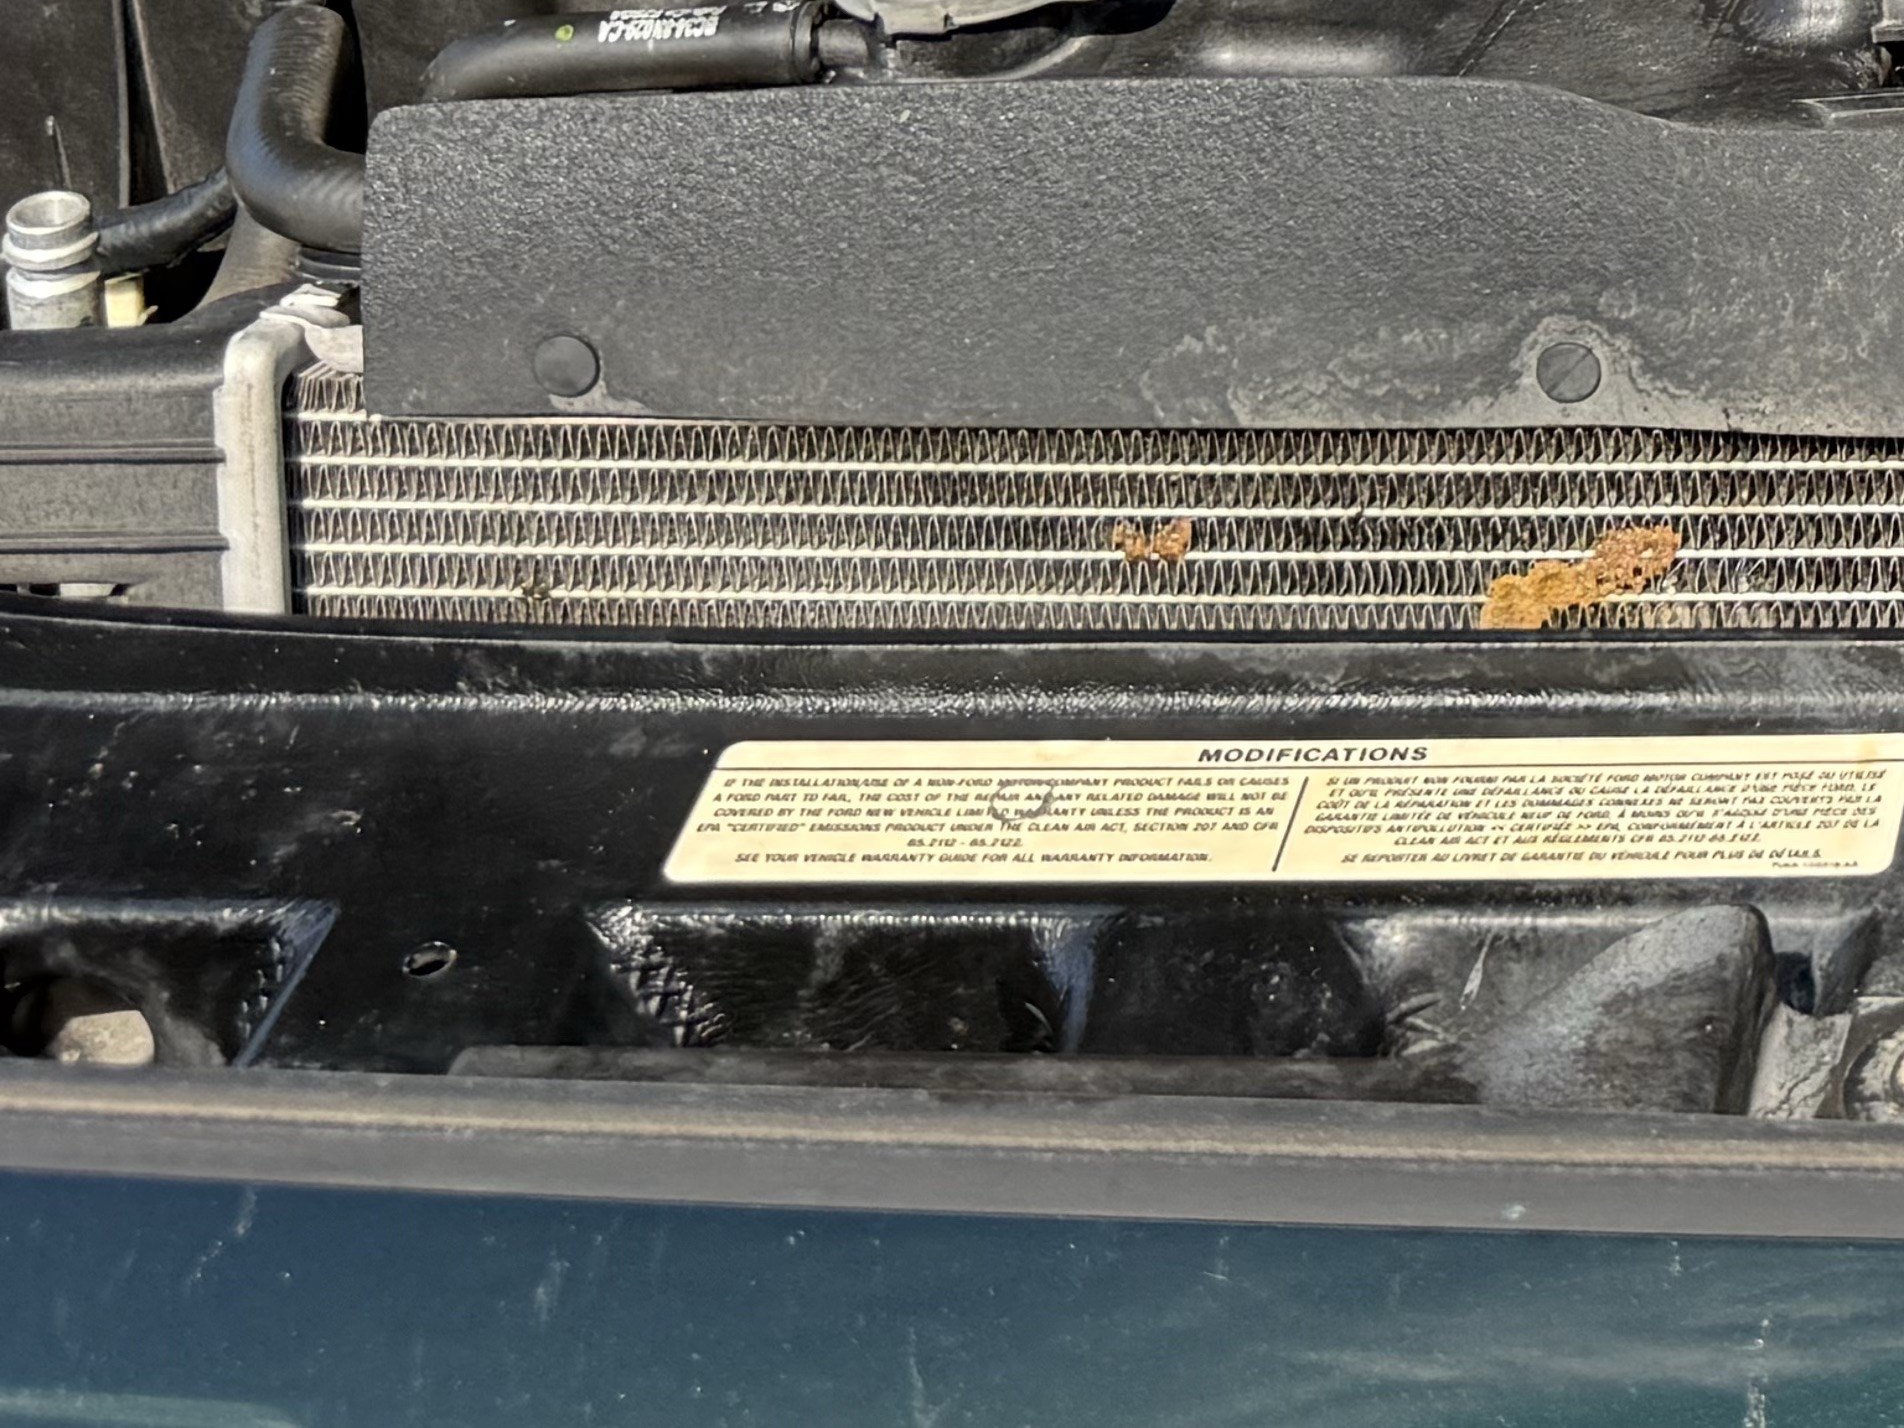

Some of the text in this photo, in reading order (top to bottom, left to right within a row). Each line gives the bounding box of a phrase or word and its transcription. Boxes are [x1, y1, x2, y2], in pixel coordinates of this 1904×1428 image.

[1199, 747, 1426, 762] MODIFICATIONS
[723, 778, 736, 787] IF
[741, 777, 765, 787] THE
[892, 777, 909, 786] OF
[913, 777, 922, 786] A
[1113, 777, 1172, 786] PRODUCT
[1176, 777, 1212, 786] FAILS
[1216, 777, 1235, 786] OR
[1239, 777, 1288, 786] CAUSES
[712, 792, 721, 802] A
[726, 792, 760, 801] FORD
[764, 792, 796, 801] PART
[802, 792, 818, 802] TO
[821, 793, 850, 802] FAIL,
[859, 792, 881, 801] THE
[886, 792, 919, 801] COST
[924, 792, 941, 801] OF
[946, 792, 969, 801] THE
[1054, 793, 1082, 802] ANY
[1086, 792, 1143, 801] RELATED
[1147, 792, 1200, 801] DAMAGE
[1205, 792, 1234, 801] WILL
[1240, 791, 1265, 801] NOT
[1270, 791, 1287, 801] BE
[713, 807, 773, 816] COVERED
[776, 807, 794, 816] BY
[799, 807, 822, 816] THE
[827, 807, 861, 816] FORD
[865, 808, 894, 816] NEW
[899, 807, 951, 816] VEHICLE
[1090, 807, 1139, 816] UNLESS
[1146, 806, 1169, 816] THE
[1174, 806, 1233, 816] PRODUCT
[1238, 806, 1250, 815] IS
[1255, 807, 1274, 815] AN
[696, 822, 720, 832] EPA
[809, 822, 880, 832] EMISSIONS
[884, 822, 945, 832] PRODUCT
[950, 823, 993, 831] UNDER
[1000, 821, 1022, 831] THE
[1027, 822, 1069, 831] CLEAN
[1074, 822, 1096, 831] AIR
[1100, 822, 1127, 832] ACT,
[1133, 822, 1188, 831] SECTION
[1193, 821, 1217, 831] 207
[1221, 821, 1248, 831] AND
[1252, 821, 1278, 831] CFR
[734, 852, 1211, 862] SEE YOUR VEHICLE WARRANTY GUIDE FOR ALL WARRANTY INFORMATION.
